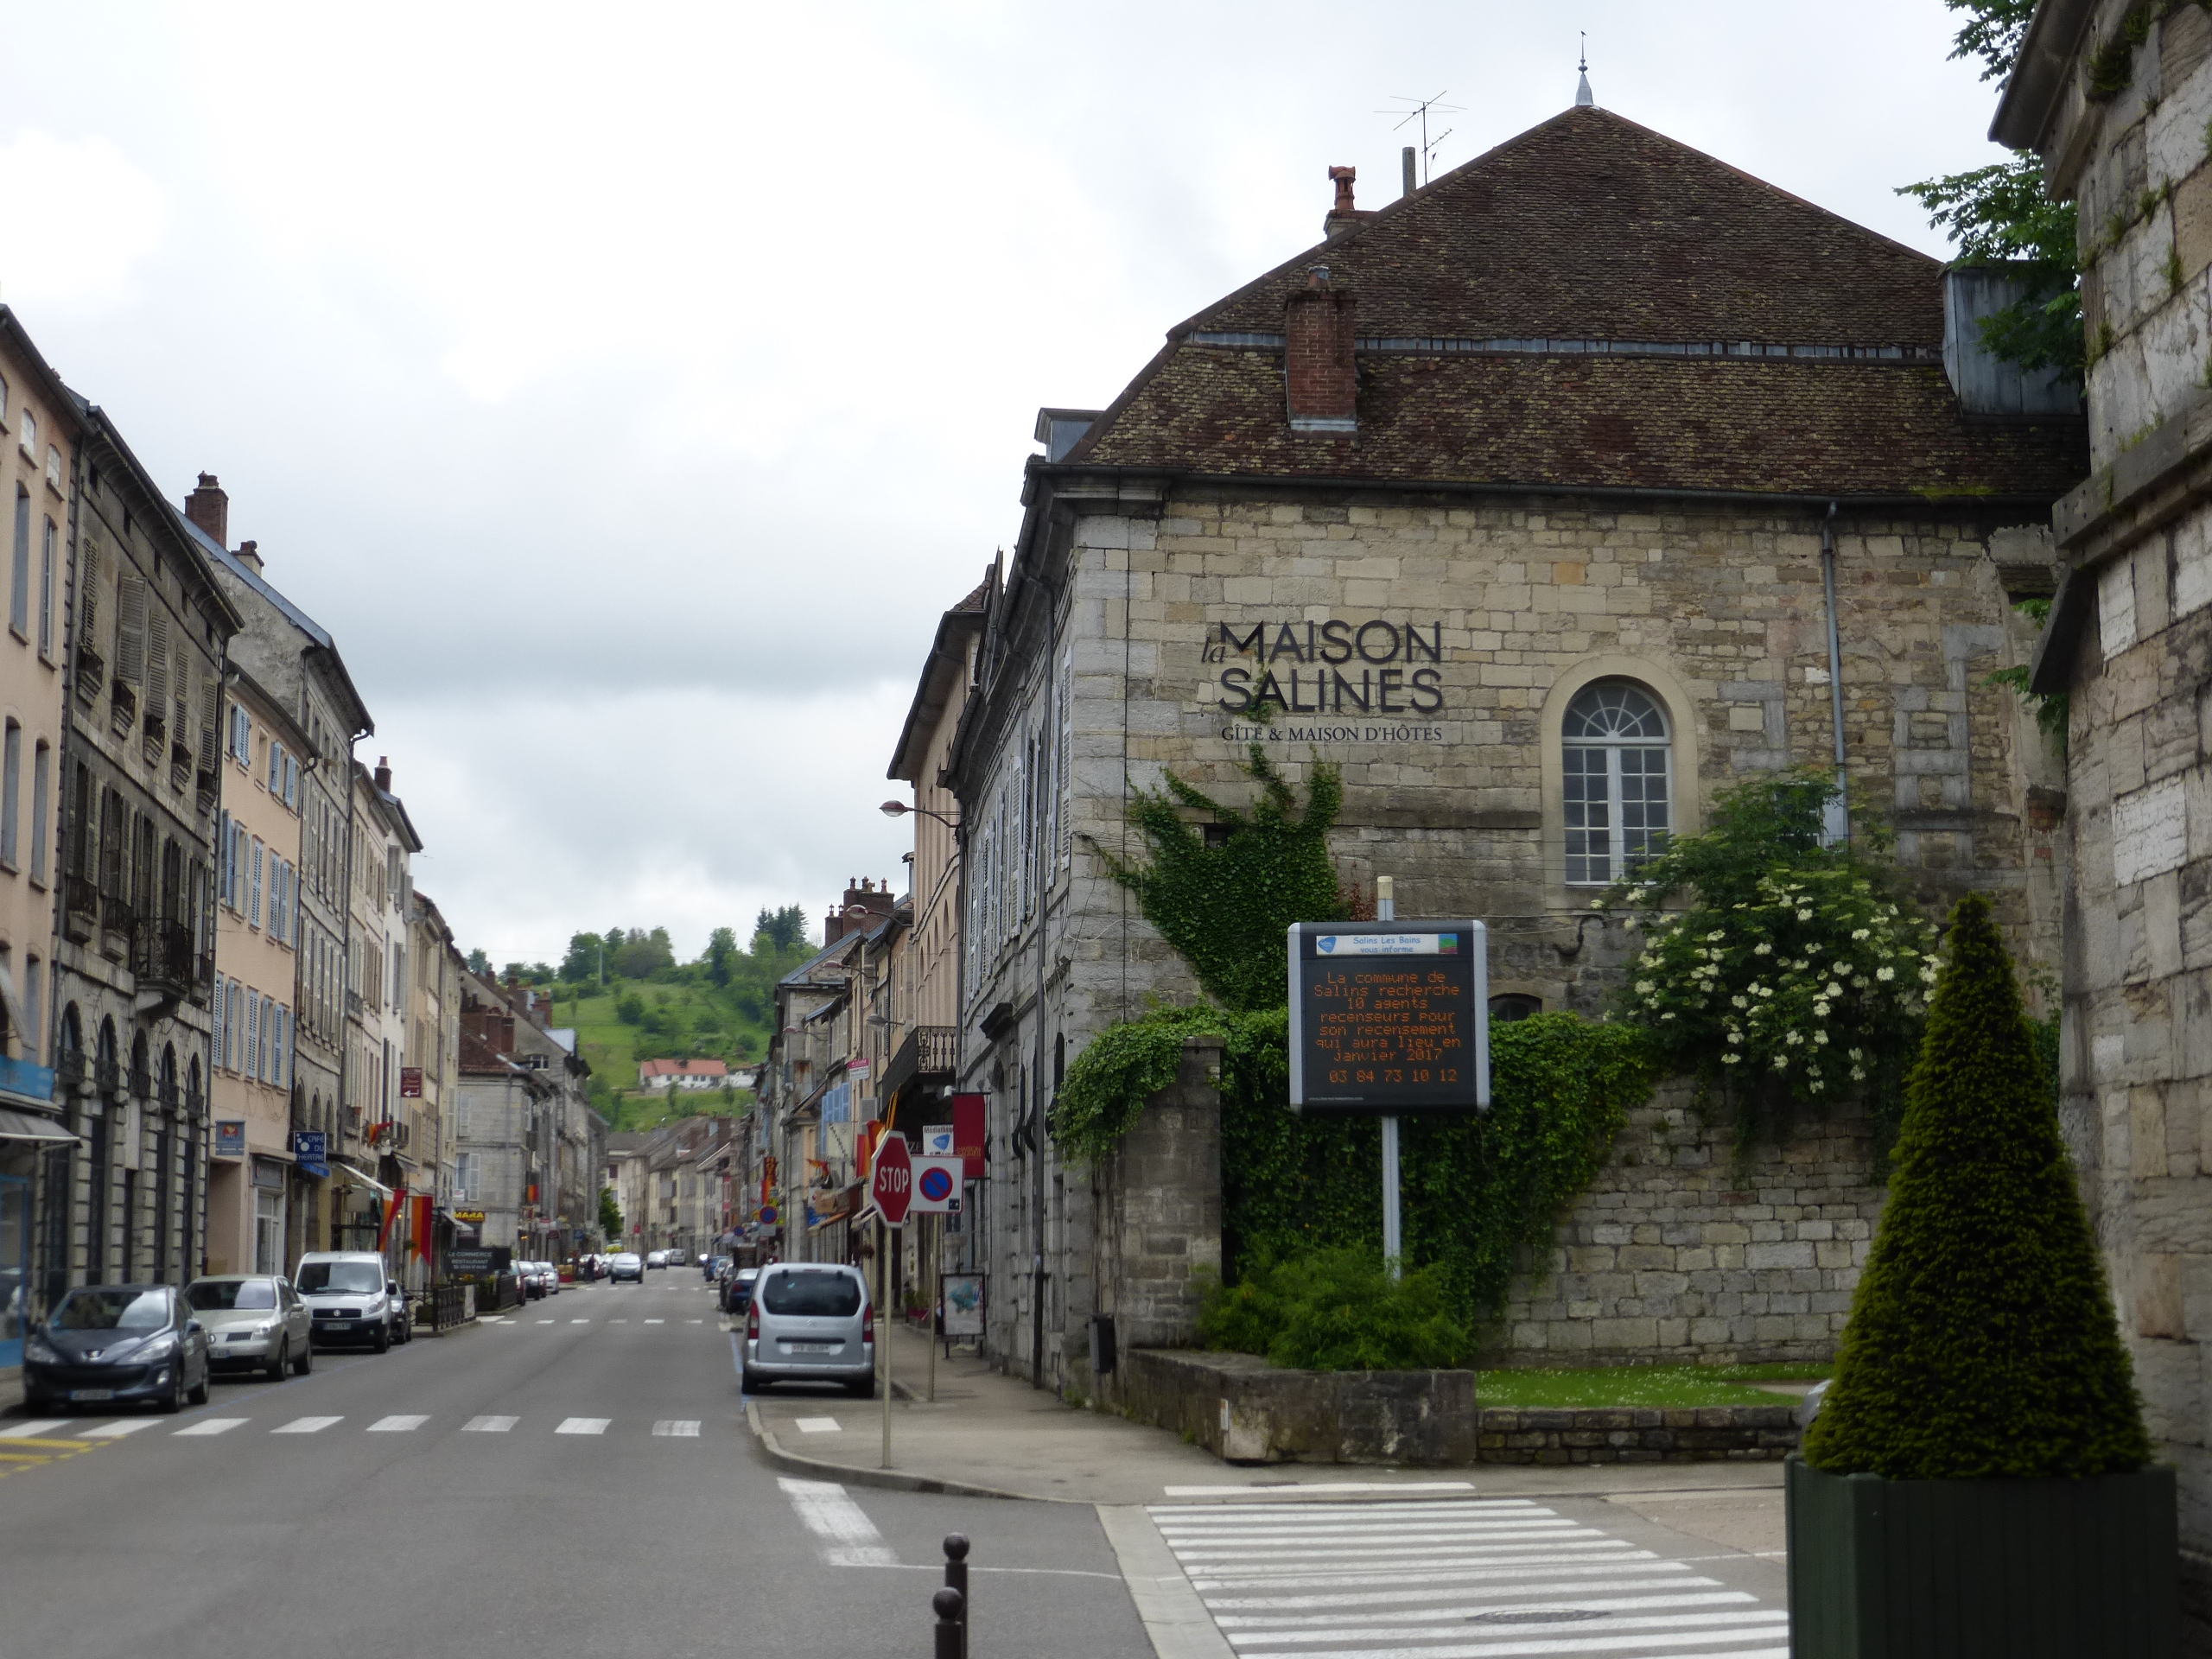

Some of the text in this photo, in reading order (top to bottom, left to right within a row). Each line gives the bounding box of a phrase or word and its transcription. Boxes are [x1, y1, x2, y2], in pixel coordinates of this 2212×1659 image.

[1201, 620, 1441, 664] la MAISON
[1219, 667, 1443, 713] SALINES
[1221, 724, 1442, 741] GÎTE & MAISON D'HÔTES
[1327, 970, 1446, 983] La commune de
[1314, 983, 1459, 996] Salins recherche
[1347, 996, 1427, 1009] 10 agents
[1320, 1012, 1455, 1022] recenseurs pour
[1319, 1022, 1456, 1035] son recensement
[1315, 1035, 1462, 1048] qui aura lieu en
[1333, 1047, 1443, 1062] janvier 2017
[1329, 1068, 1458, 1083] 03 84 73 10 12
[879, 1166, 909, 1193] STOP
